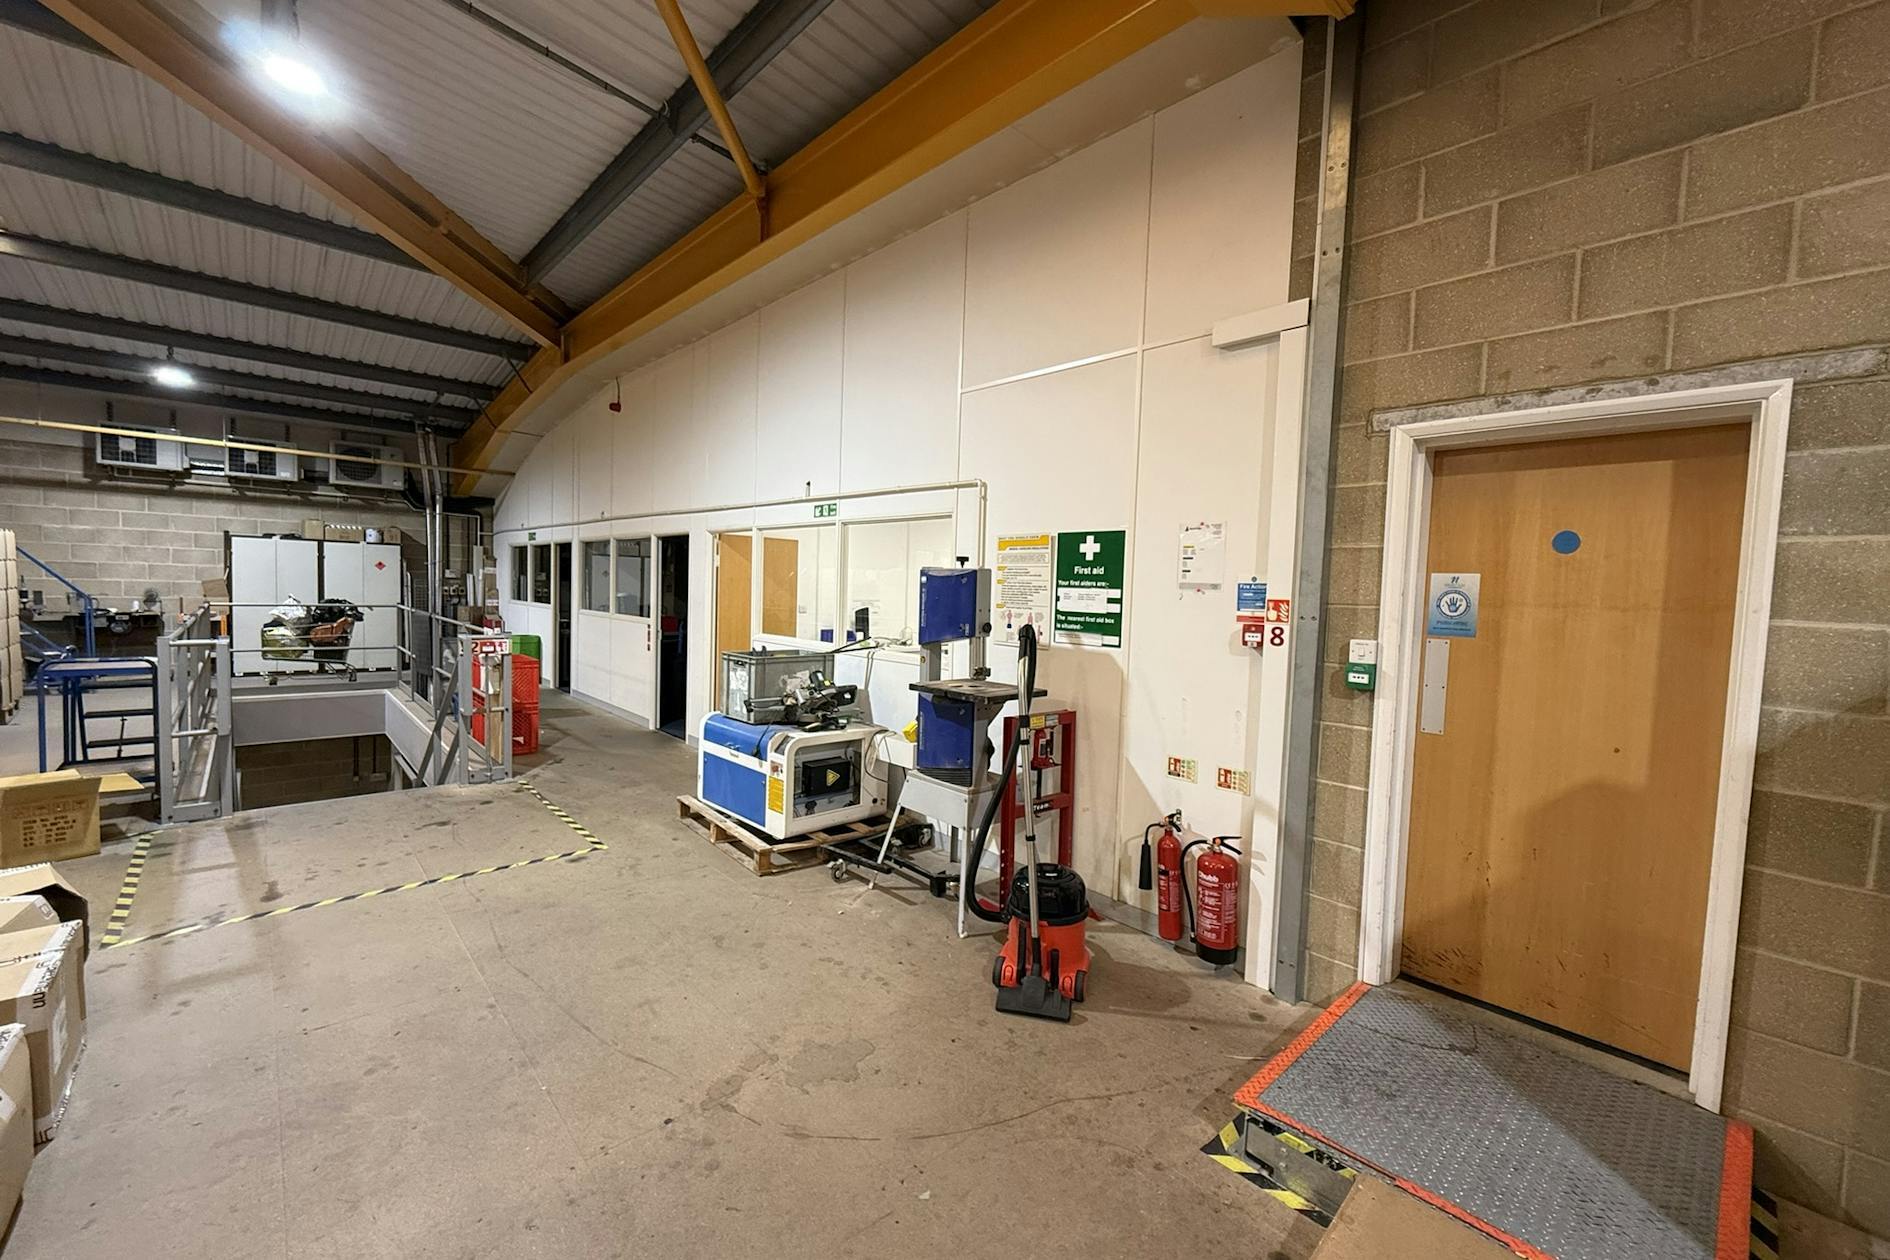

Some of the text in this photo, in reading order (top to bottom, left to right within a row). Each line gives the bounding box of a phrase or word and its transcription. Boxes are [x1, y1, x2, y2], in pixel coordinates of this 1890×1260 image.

[1074, 565, 1105, 575] First aid
[1270, 626, 1285, 647] 8
